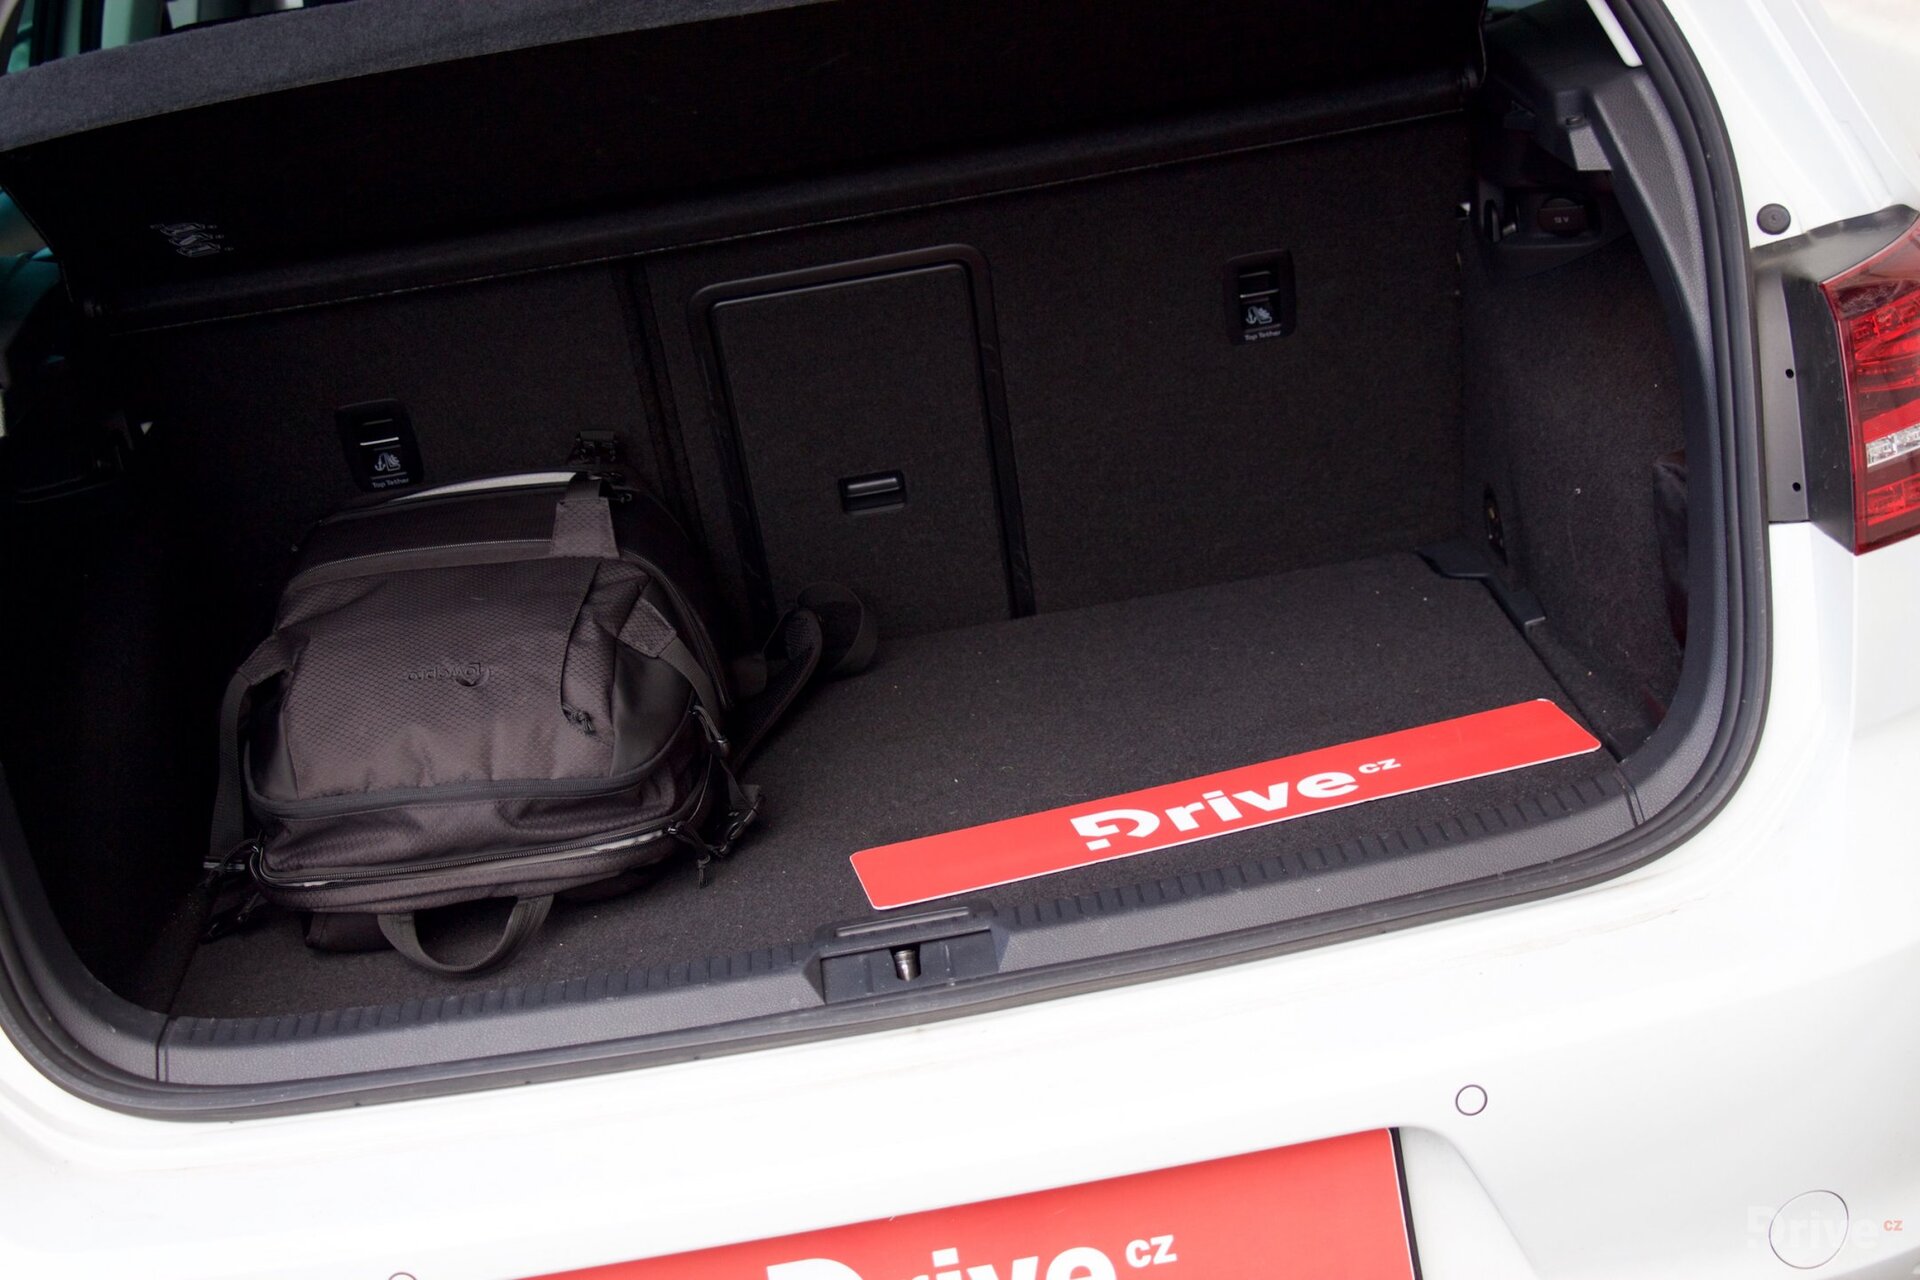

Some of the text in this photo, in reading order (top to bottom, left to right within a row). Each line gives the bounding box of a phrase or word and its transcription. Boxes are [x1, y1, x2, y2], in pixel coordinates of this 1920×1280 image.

[1070, 758, 1401, 851] Drive cz
[1125, 1234, 1177, 1268] cz
